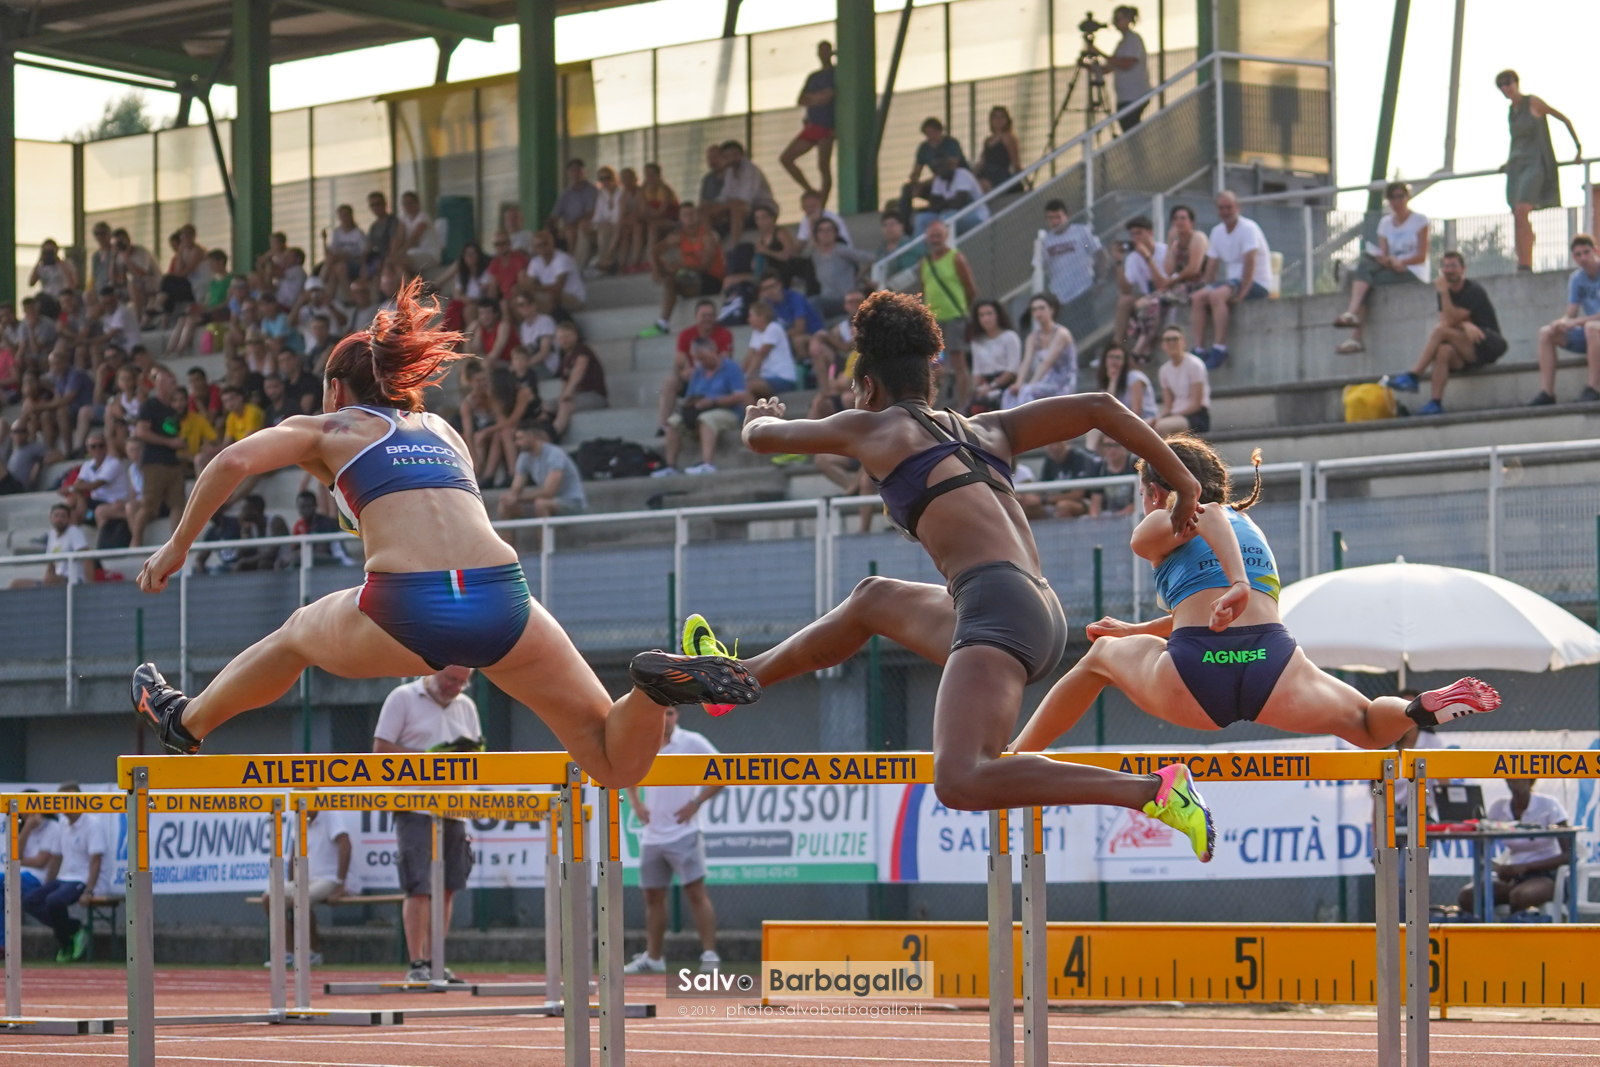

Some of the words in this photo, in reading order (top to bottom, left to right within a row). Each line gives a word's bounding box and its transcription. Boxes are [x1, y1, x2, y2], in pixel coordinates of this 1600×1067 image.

[385, 444, 456, 458] BRACCO
[392, 457, 459, 468] Atletica
[1197, 556, 1274, 571] PINOLO
[1202, 648, 1267, 664] AGNESE
[241, 758, 372, 784] ATLETICA
[381, 757, 478, 782] SALETTI
[703, 757, 821, 781] ATLETICA
[829, 757, 916, 780] SALETTI
[1231, 755, 1310, 777] SALETTI
[1493, 754, 1589, 775] ATLETICA
[25, 795, 104, 811] MEETING
[109, 795, 159, 810] CIA'
[167, 795, 183, 810] DI
[190, 795, 263, 810] NEMBRO
[313, 794, 388, 809] MEETING
[393, 794, 441, 808] CITTA'
[448, 794, 463, 808] DI
[469, 794, 540, 809] NEMBRO
[796, 832, 868, 857] PULIZIE
[939, 827, 1065, 852] SALTI
[150, 863, 219, 884] BBIGLIAMENTO
[229, 862, 270, 881] ACCESSO
[1063, 935, 1085, 988] 4
[1234, 936, 1258, 991] 5
